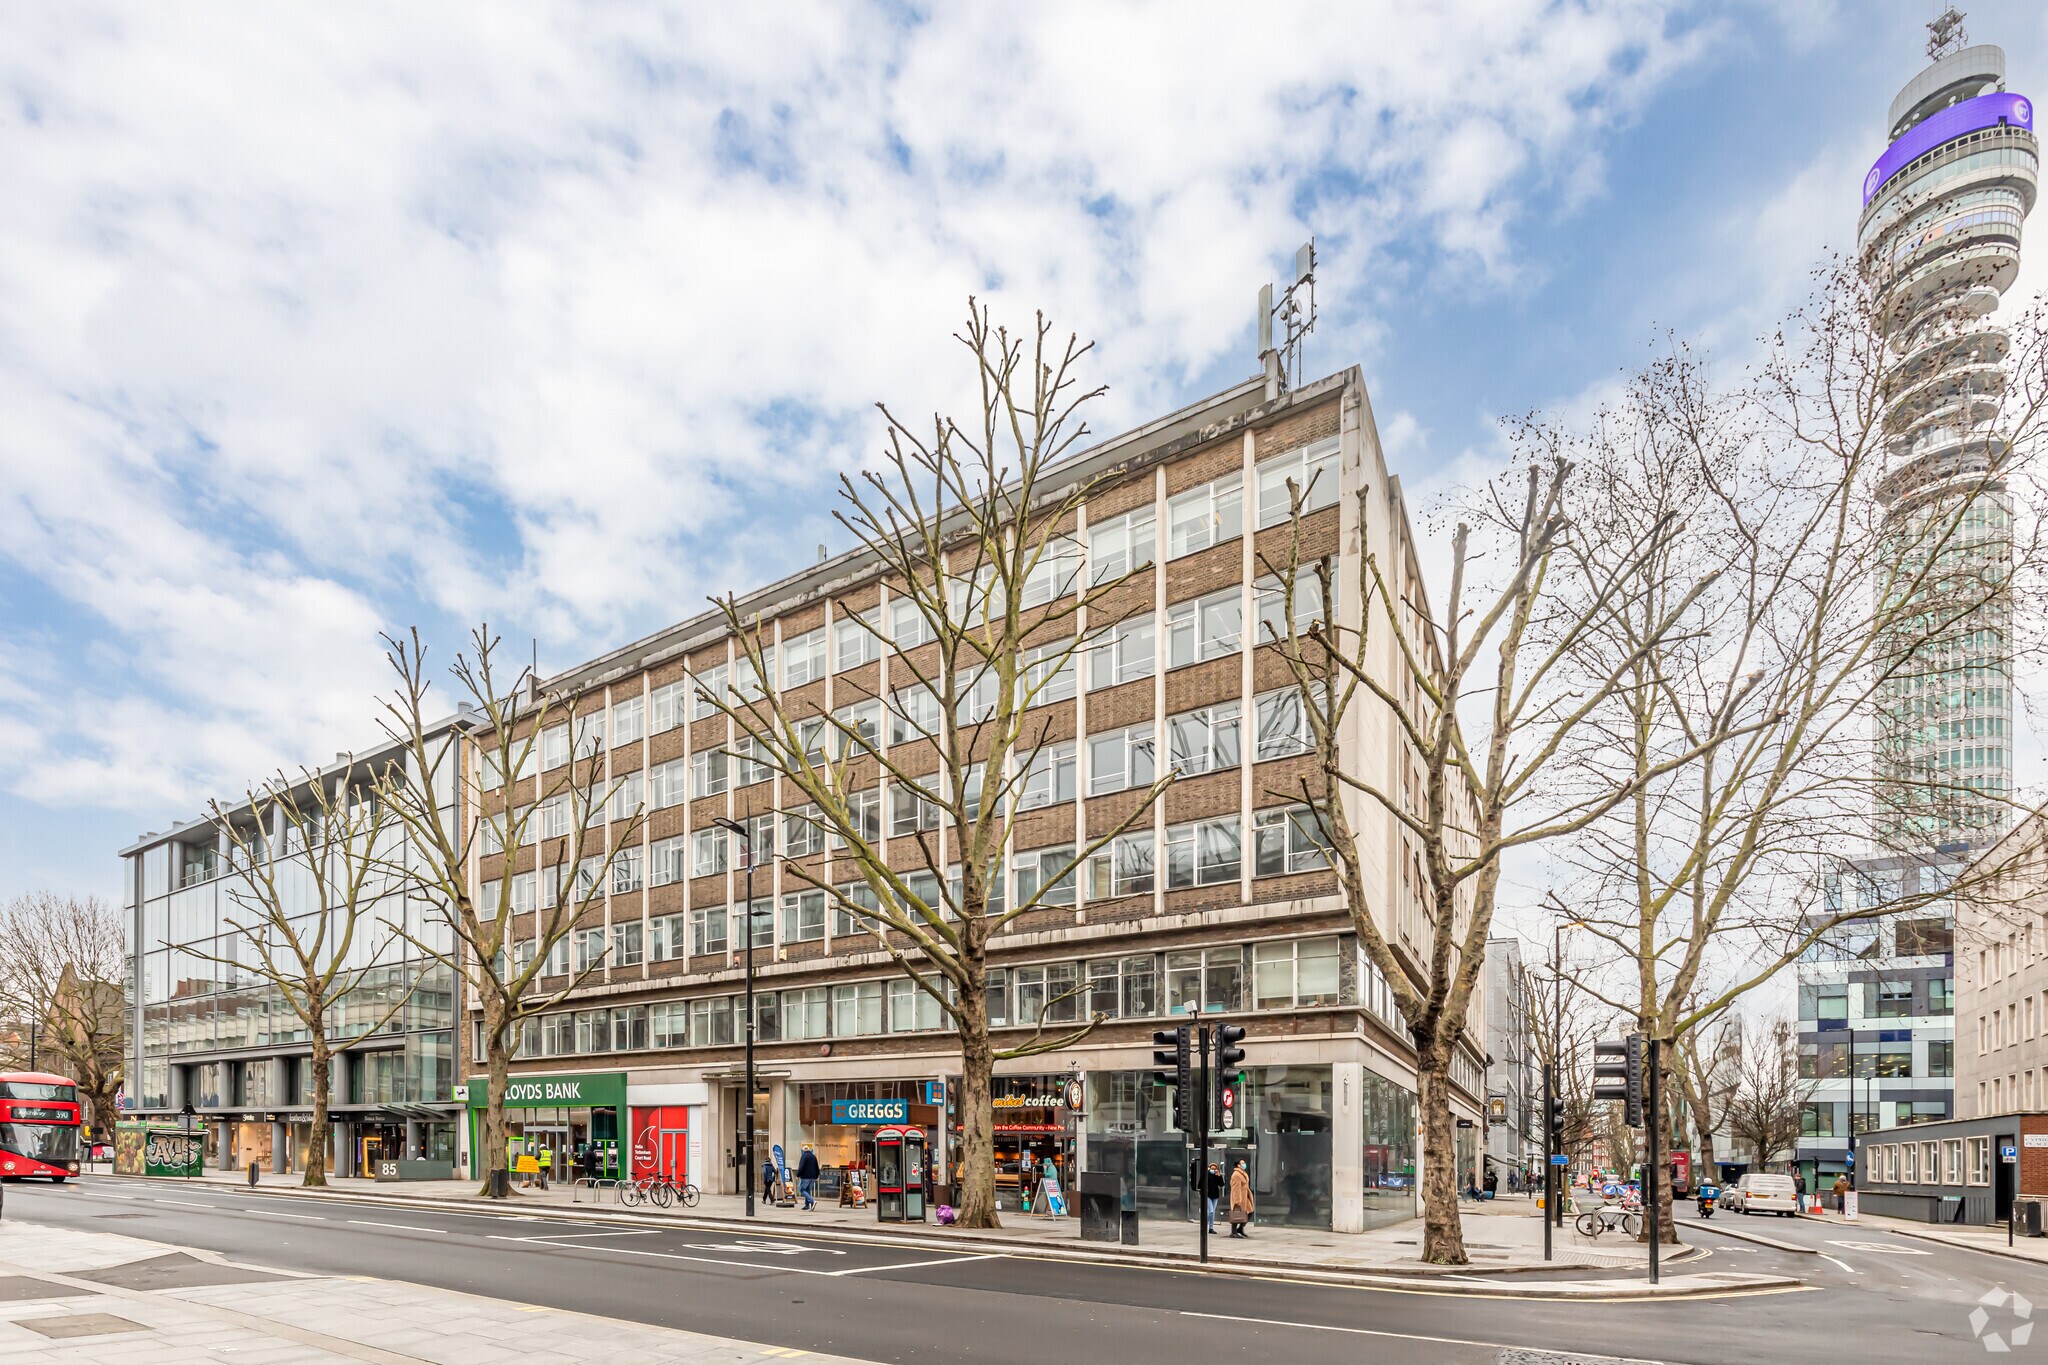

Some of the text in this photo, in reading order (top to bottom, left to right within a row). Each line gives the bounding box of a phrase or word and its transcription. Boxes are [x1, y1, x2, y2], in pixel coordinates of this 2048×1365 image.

[505, 1082, 581, 1100] LOYDS BANK
[992, 1093, 1064, 1108] mikel coffee
[56, 1110, 69, 1119] 390
[848, 1103, 903, 1118] GREGGS
[2005, 1147, 2015, 1156] P
[382, 1163, 397, 1175] 85
